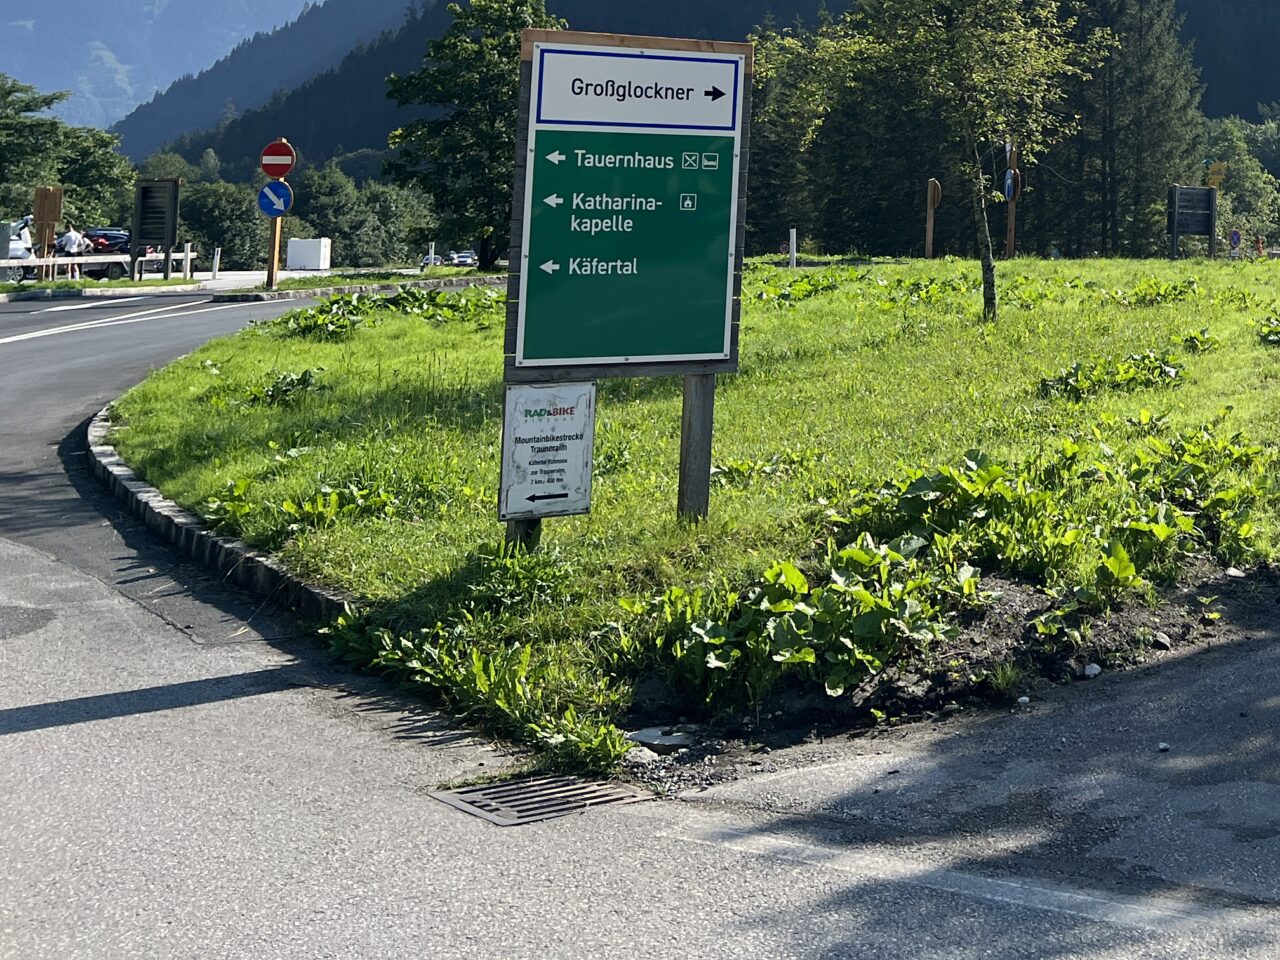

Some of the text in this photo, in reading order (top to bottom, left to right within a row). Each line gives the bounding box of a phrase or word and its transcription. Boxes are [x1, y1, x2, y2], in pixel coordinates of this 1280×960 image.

[571, 78, 694, 101] Großglockner
[574, 150, 674, 168] Tauernhaus
[572, 193, 662, 210] Katharina-
[570, 215, 633, 235] kapelle
[568, 258, 637, 274] Käfertal
[525, 407, 575, 418] RAD&BIKE
[515, 433, 583, 444] Mountainbikestrecke
